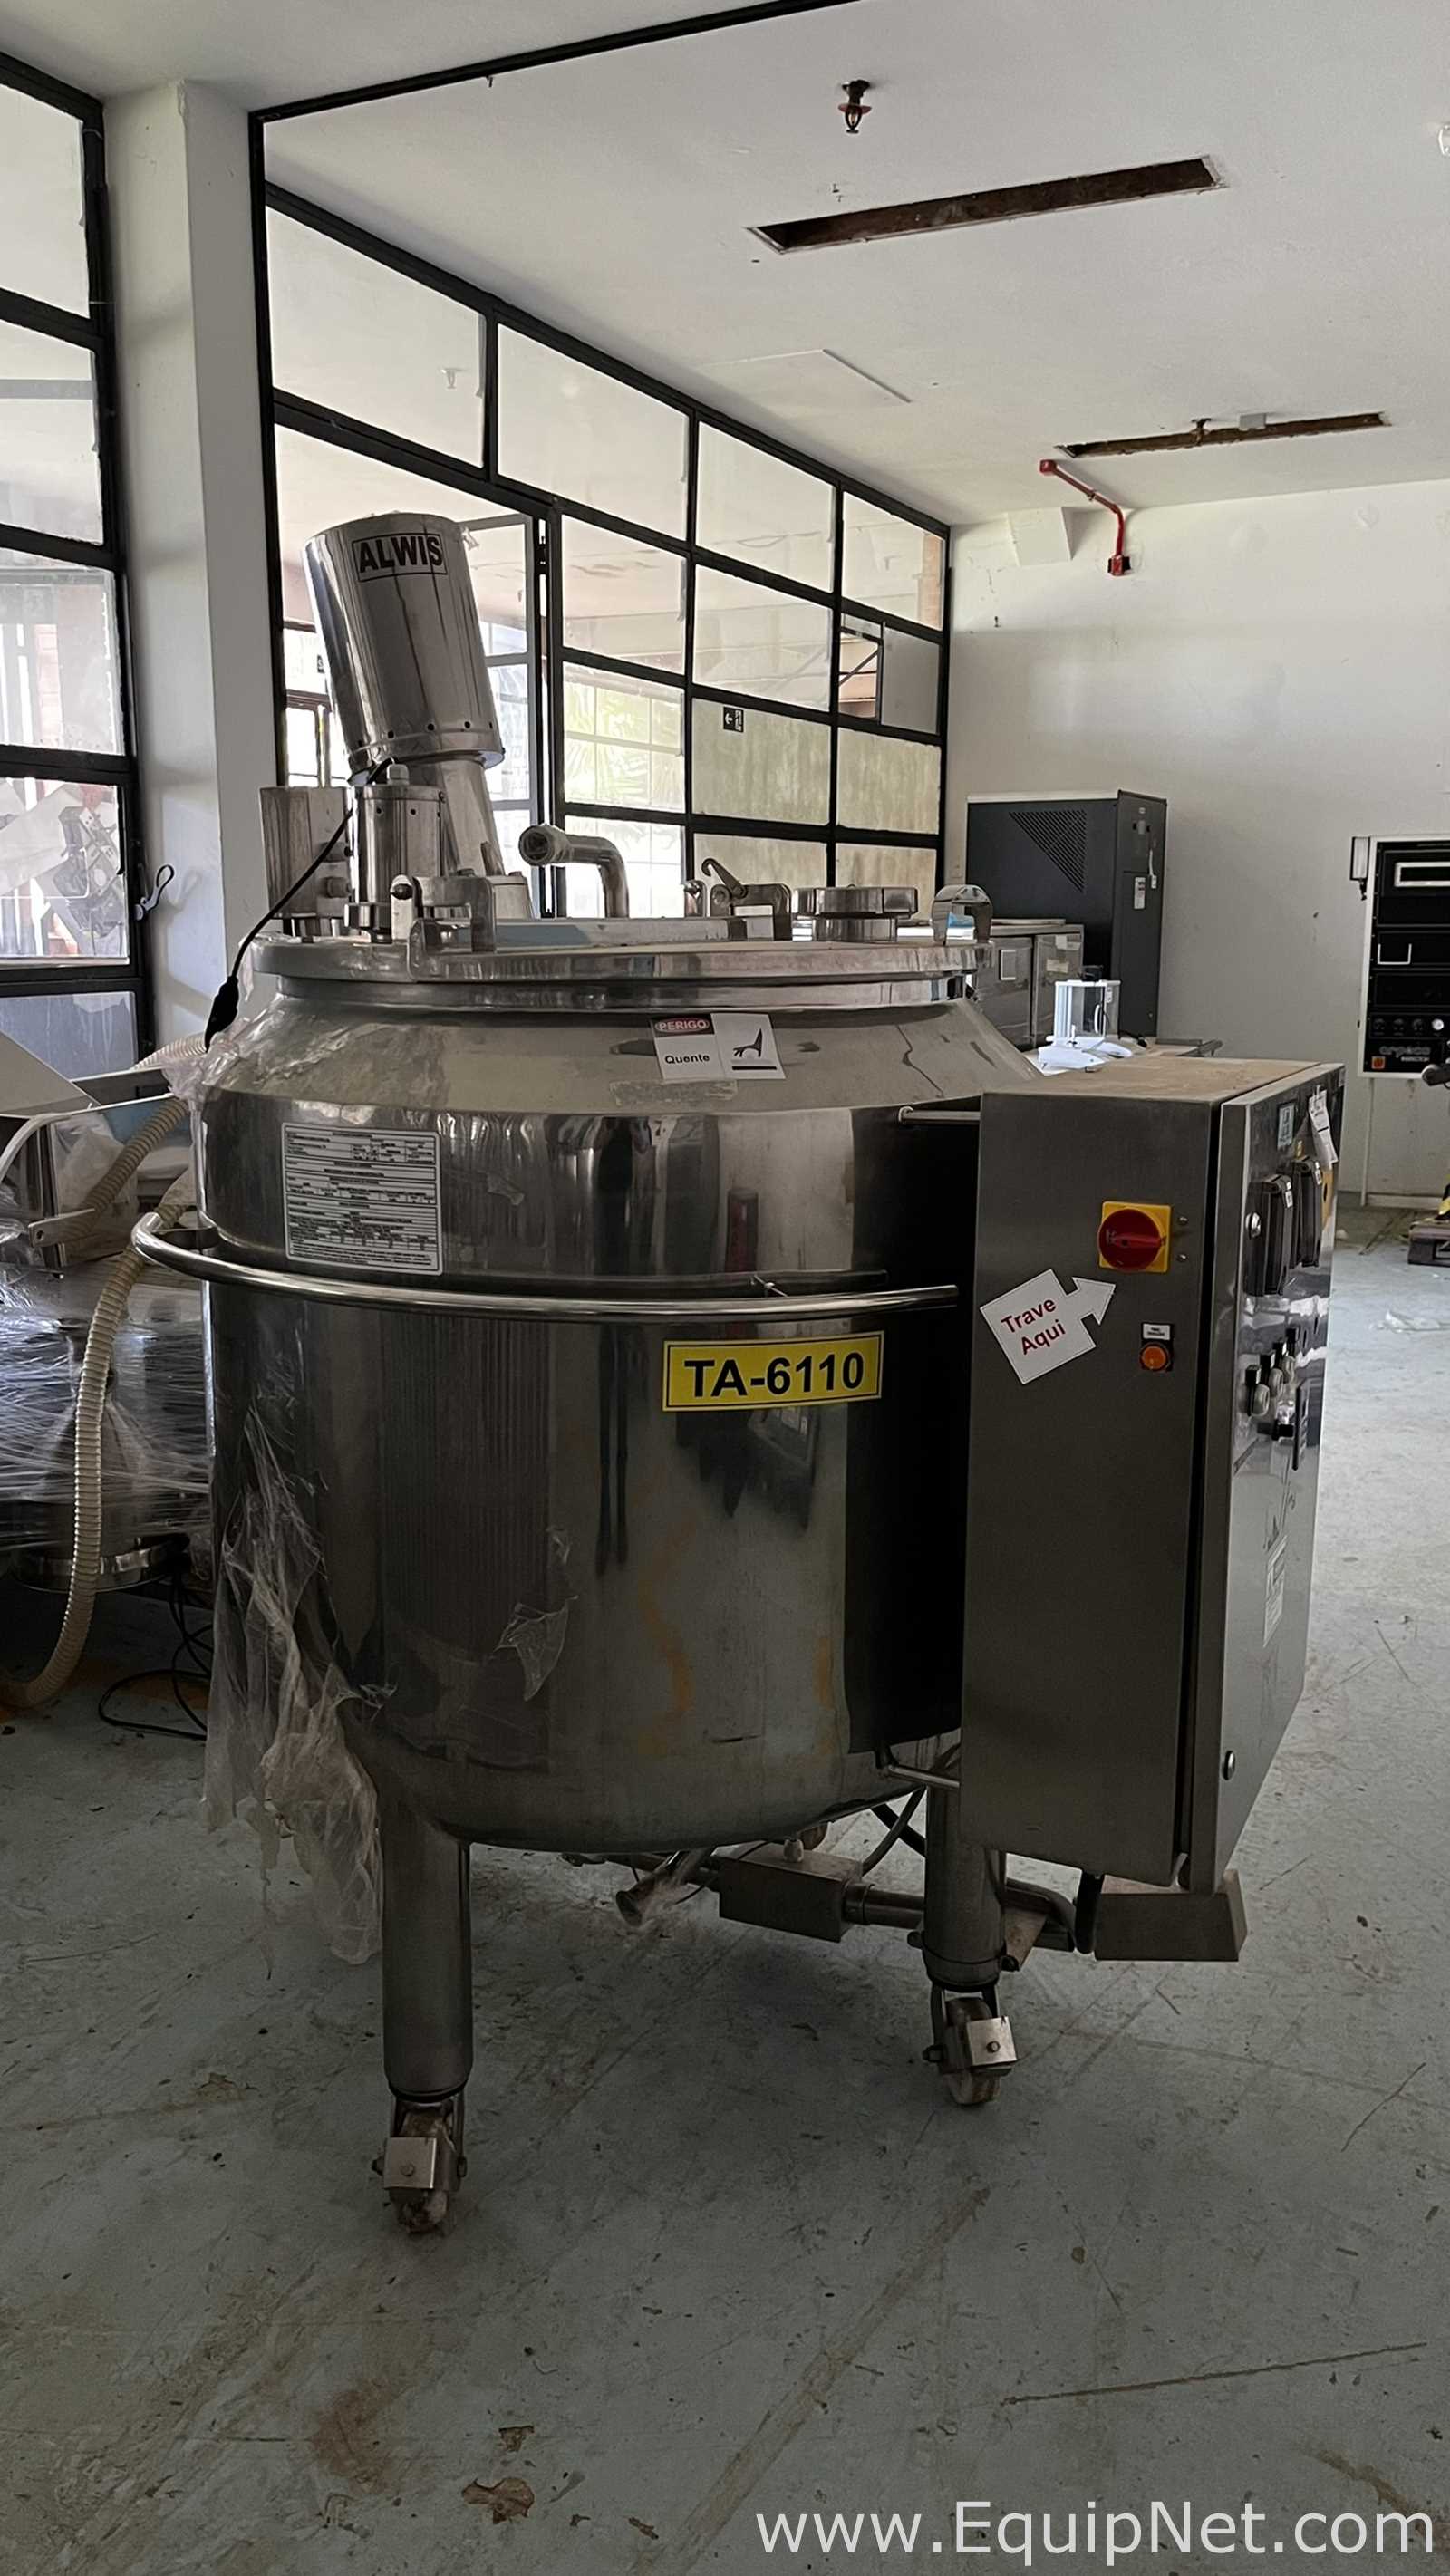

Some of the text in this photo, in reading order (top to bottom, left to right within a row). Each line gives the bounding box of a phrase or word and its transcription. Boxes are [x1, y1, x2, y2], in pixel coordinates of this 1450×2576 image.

[360, 536, 442, 573] ALWIS
[659, 1020, 707, 1030] PERIGO
[665, 1054, 710, 1065] Quente
[1000, 1299, 1057, 1333] Trave
[1021, 1318, 1066, 1356] Aqui
[684, 1351, 865, 1397] TA-6110
